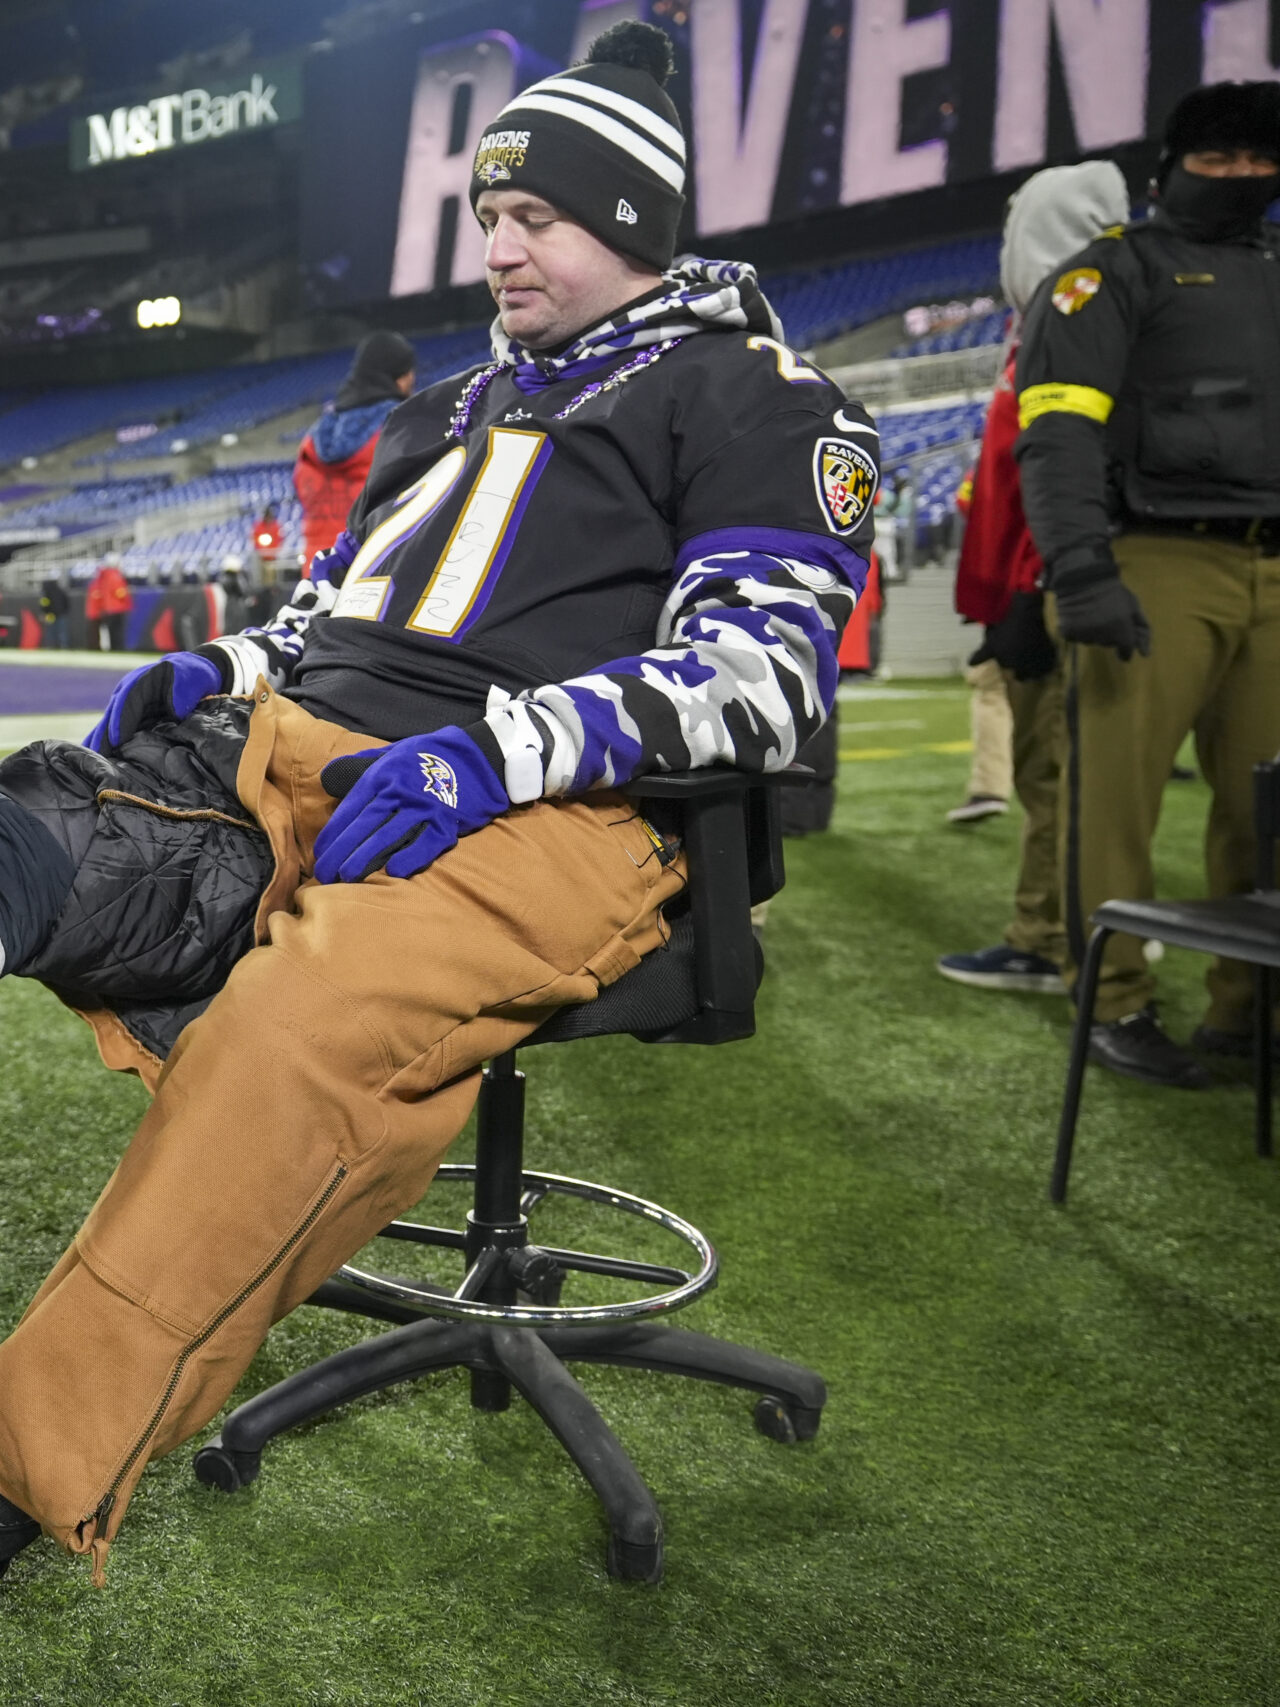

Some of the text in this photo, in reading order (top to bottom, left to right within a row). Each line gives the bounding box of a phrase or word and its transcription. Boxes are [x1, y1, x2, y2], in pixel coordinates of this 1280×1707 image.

[86, 73, 279, 165] M&T Bank
[825, 444, 875, 480] RAVENS
[328, 426, 555, 644] 21
